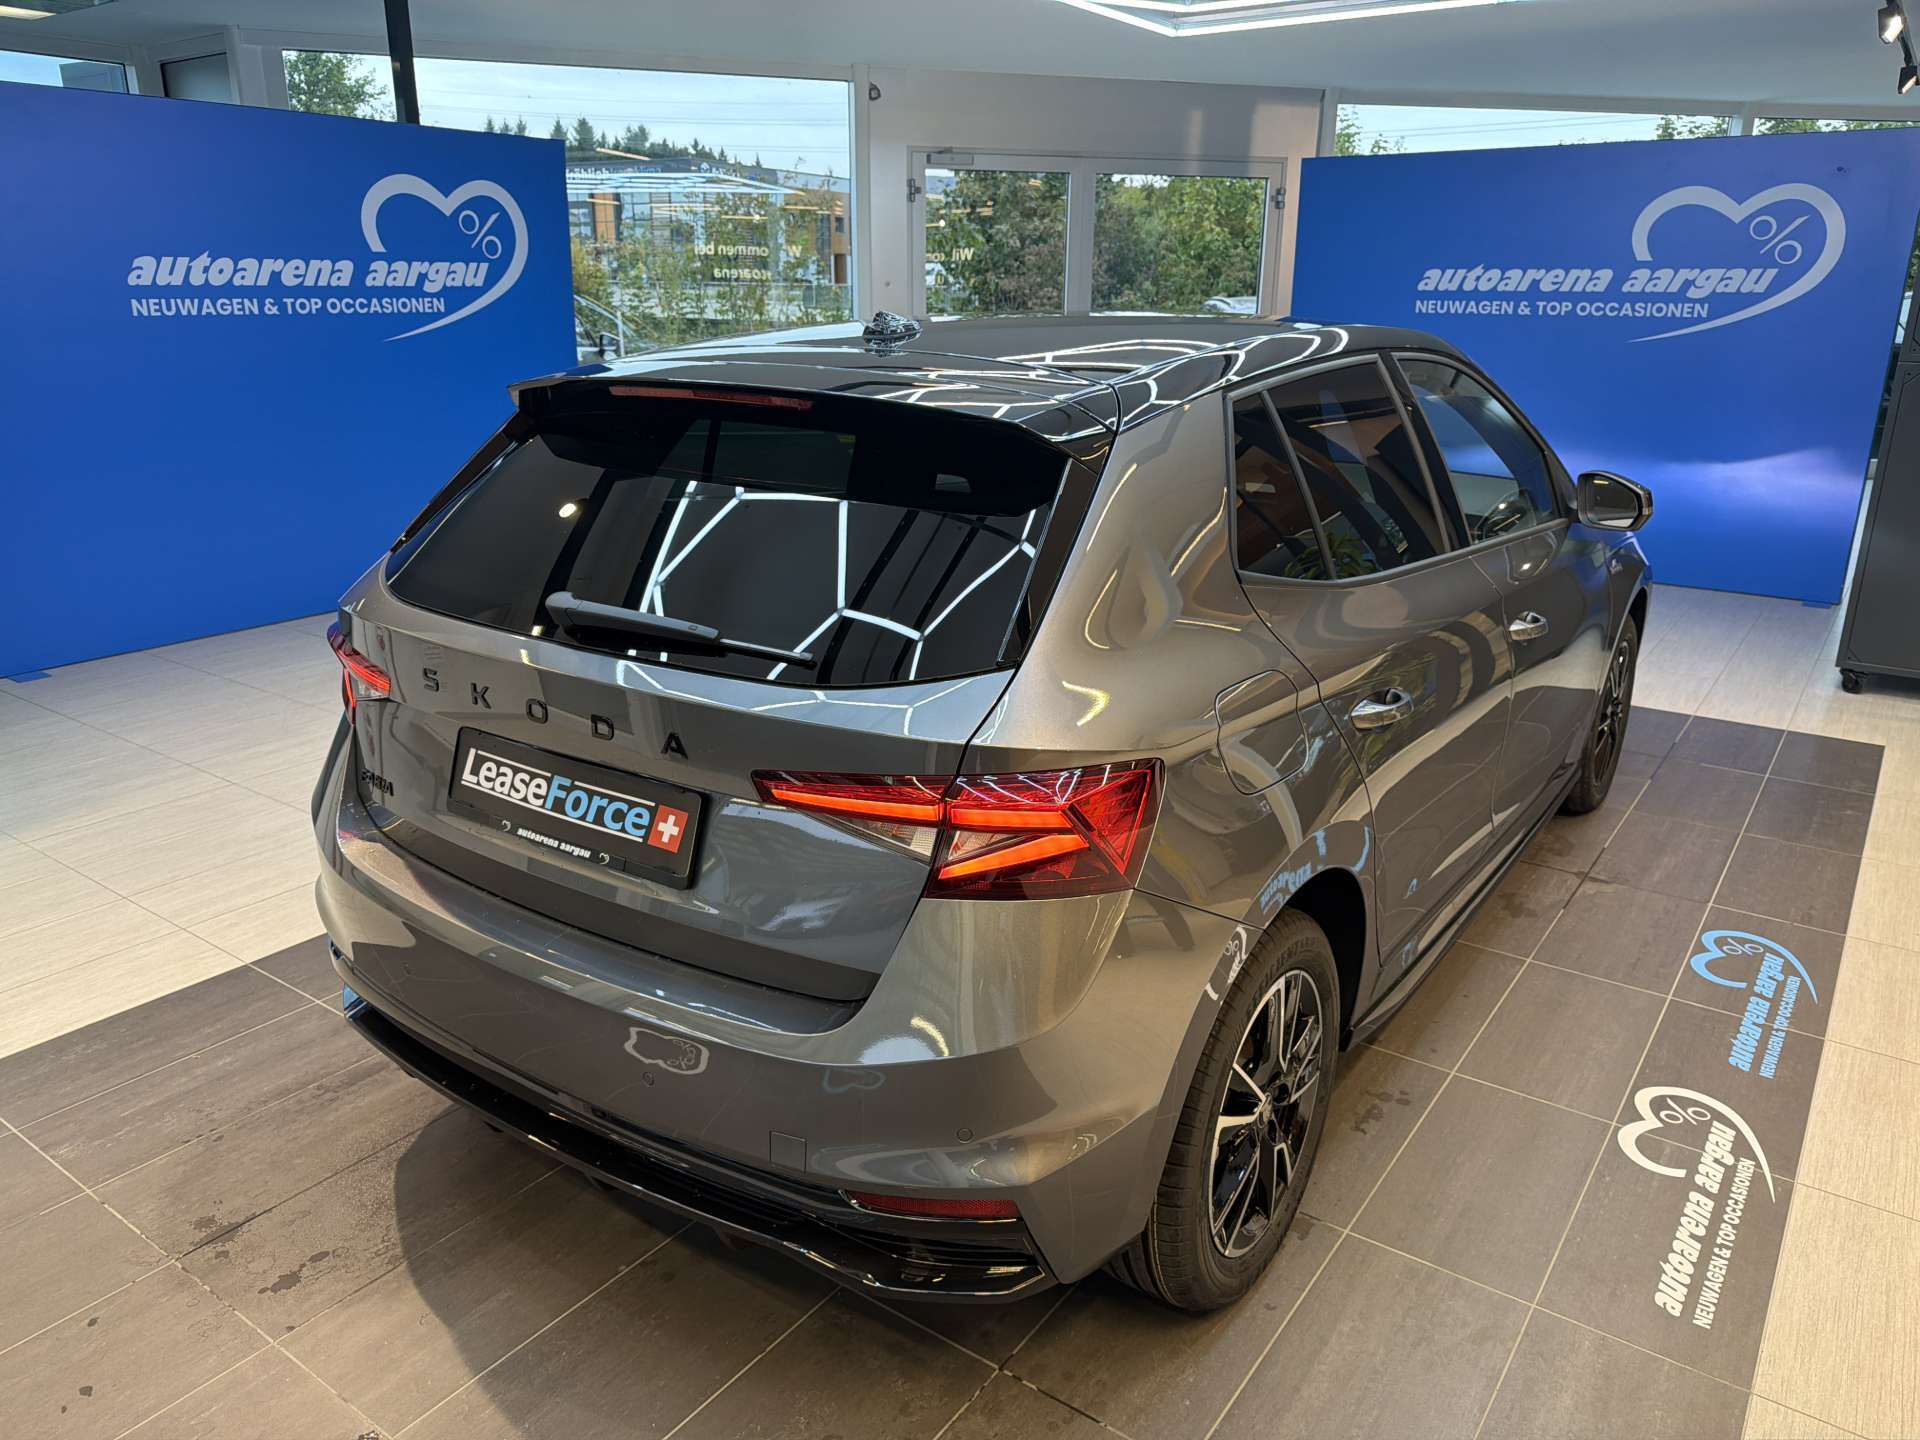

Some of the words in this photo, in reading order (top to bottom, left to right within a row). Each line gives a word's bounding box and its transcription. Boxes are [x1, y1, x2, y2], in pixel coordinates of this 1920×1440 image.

[127, 250, 351, 288] autoarena
[364, 260, 489, 294] aargau
[1417, 263, 1614, 293] autoarena
[1622, 266, 1779, 299] aargau
[130, 298, 260, 318] NEUWAGEN
[263, 298, 279, 316] &
[283, 298, 323, 316] TOP
[326, 298, 446, 315] OCCASIONEN
[1415, 300, 1515, 316] NEUWAGEN
[1517, 301, 1532, 316] &
[1536, 301, 1573, 317] TOP
[1577, 301, 1709, 318] OCCASIONEN
[461, 749, 650, 838] LeaseForce
[516, 827, 559, 849] autoarena
[559, 841, 591, 860] aargau
[1728, 996, 1771, 1072] autoarena
[1753, 952, 1785, 998] aargau
[1759, 1036, 1785, 1079] NEUWAGEN
[1776, 975, 1801, 1017] OCCASIONEN
[1722, 1157, 1756, 1225] OCCASIONEN
[1654, 1191, 1715, 1317] autoarena
[1694, 1120, 1737, 1194] aargau
[1706, 1222, 1737, 1247] TOP
[1703, 1247, 1732, 1258] &
[1692, 1256, 1729, 1329] NEUWAGEN
